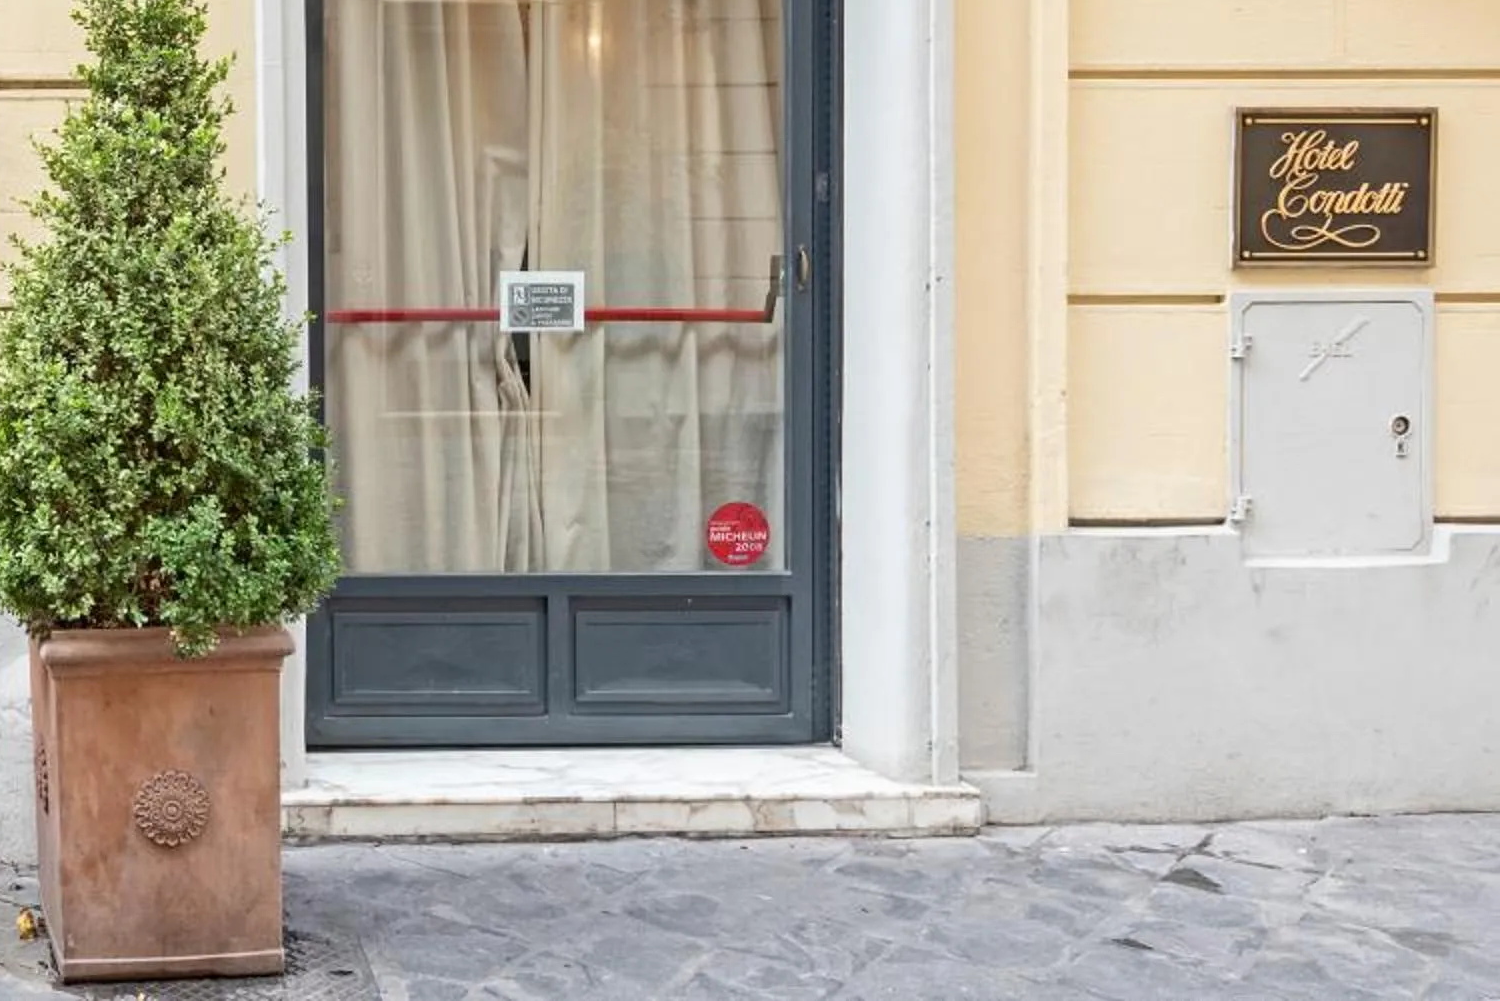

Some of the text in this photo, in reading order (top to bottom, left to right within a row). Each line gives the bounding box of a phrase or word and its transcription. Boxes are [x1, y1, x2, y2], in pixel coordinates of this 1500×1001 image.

[1269, 129, 1360, 179] Hotel
[1265, 171, 1409, 239] Condotti
[709, 530, 767, 542] MICHELIN
